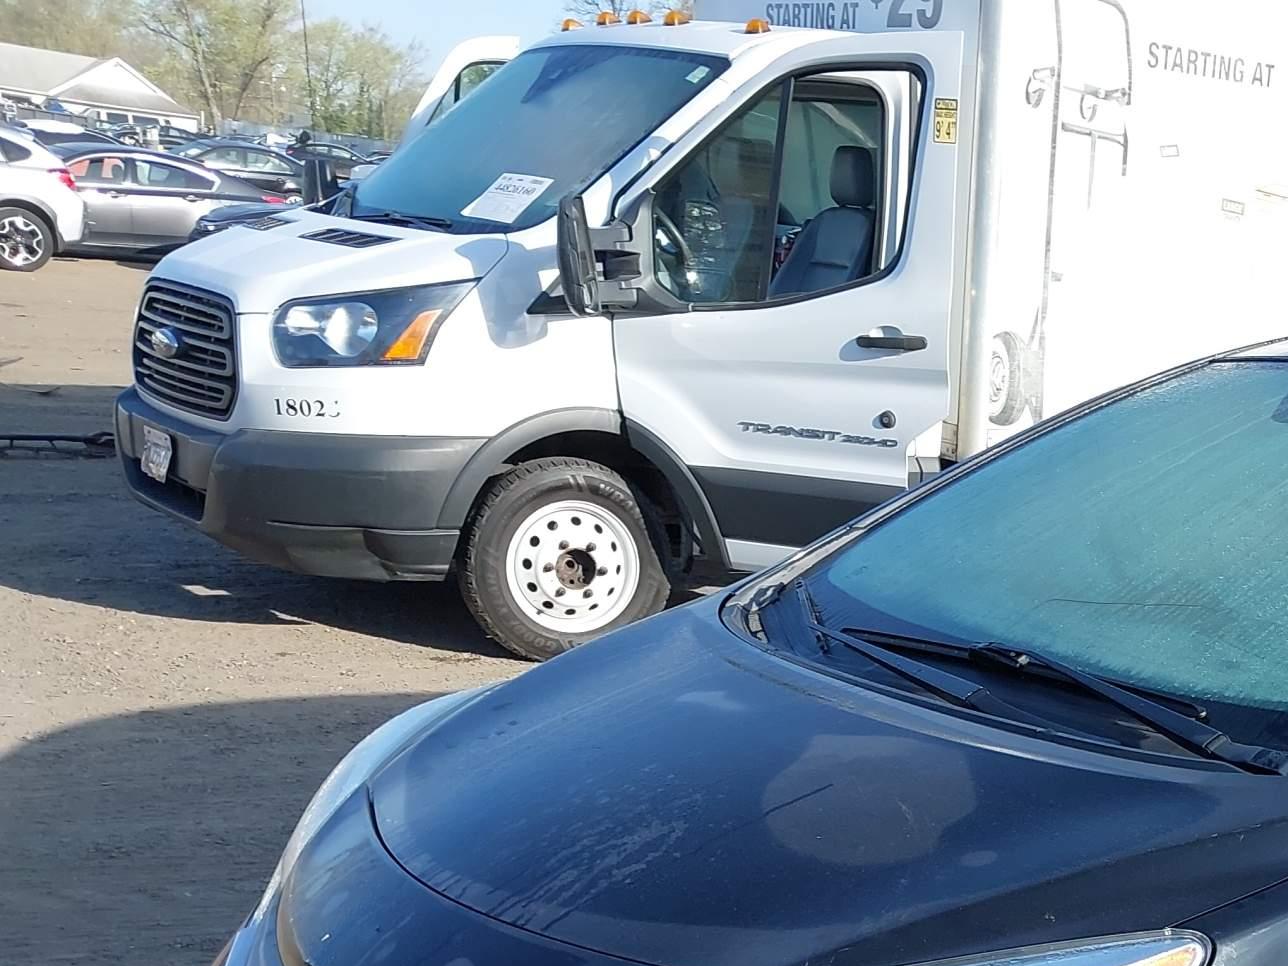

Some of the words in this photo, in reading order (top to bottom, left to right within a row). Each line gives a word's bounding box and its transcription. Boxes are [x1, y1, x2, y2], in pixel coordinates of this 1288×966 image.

[766, 3, 836, 29] STARTING
[840, 2, 860, 30] AT
[1147, 42, 1245, 83] STARTING
[1251, 61, 1275, 88] AT
[737, 421, 842, 441] TRANSIT
